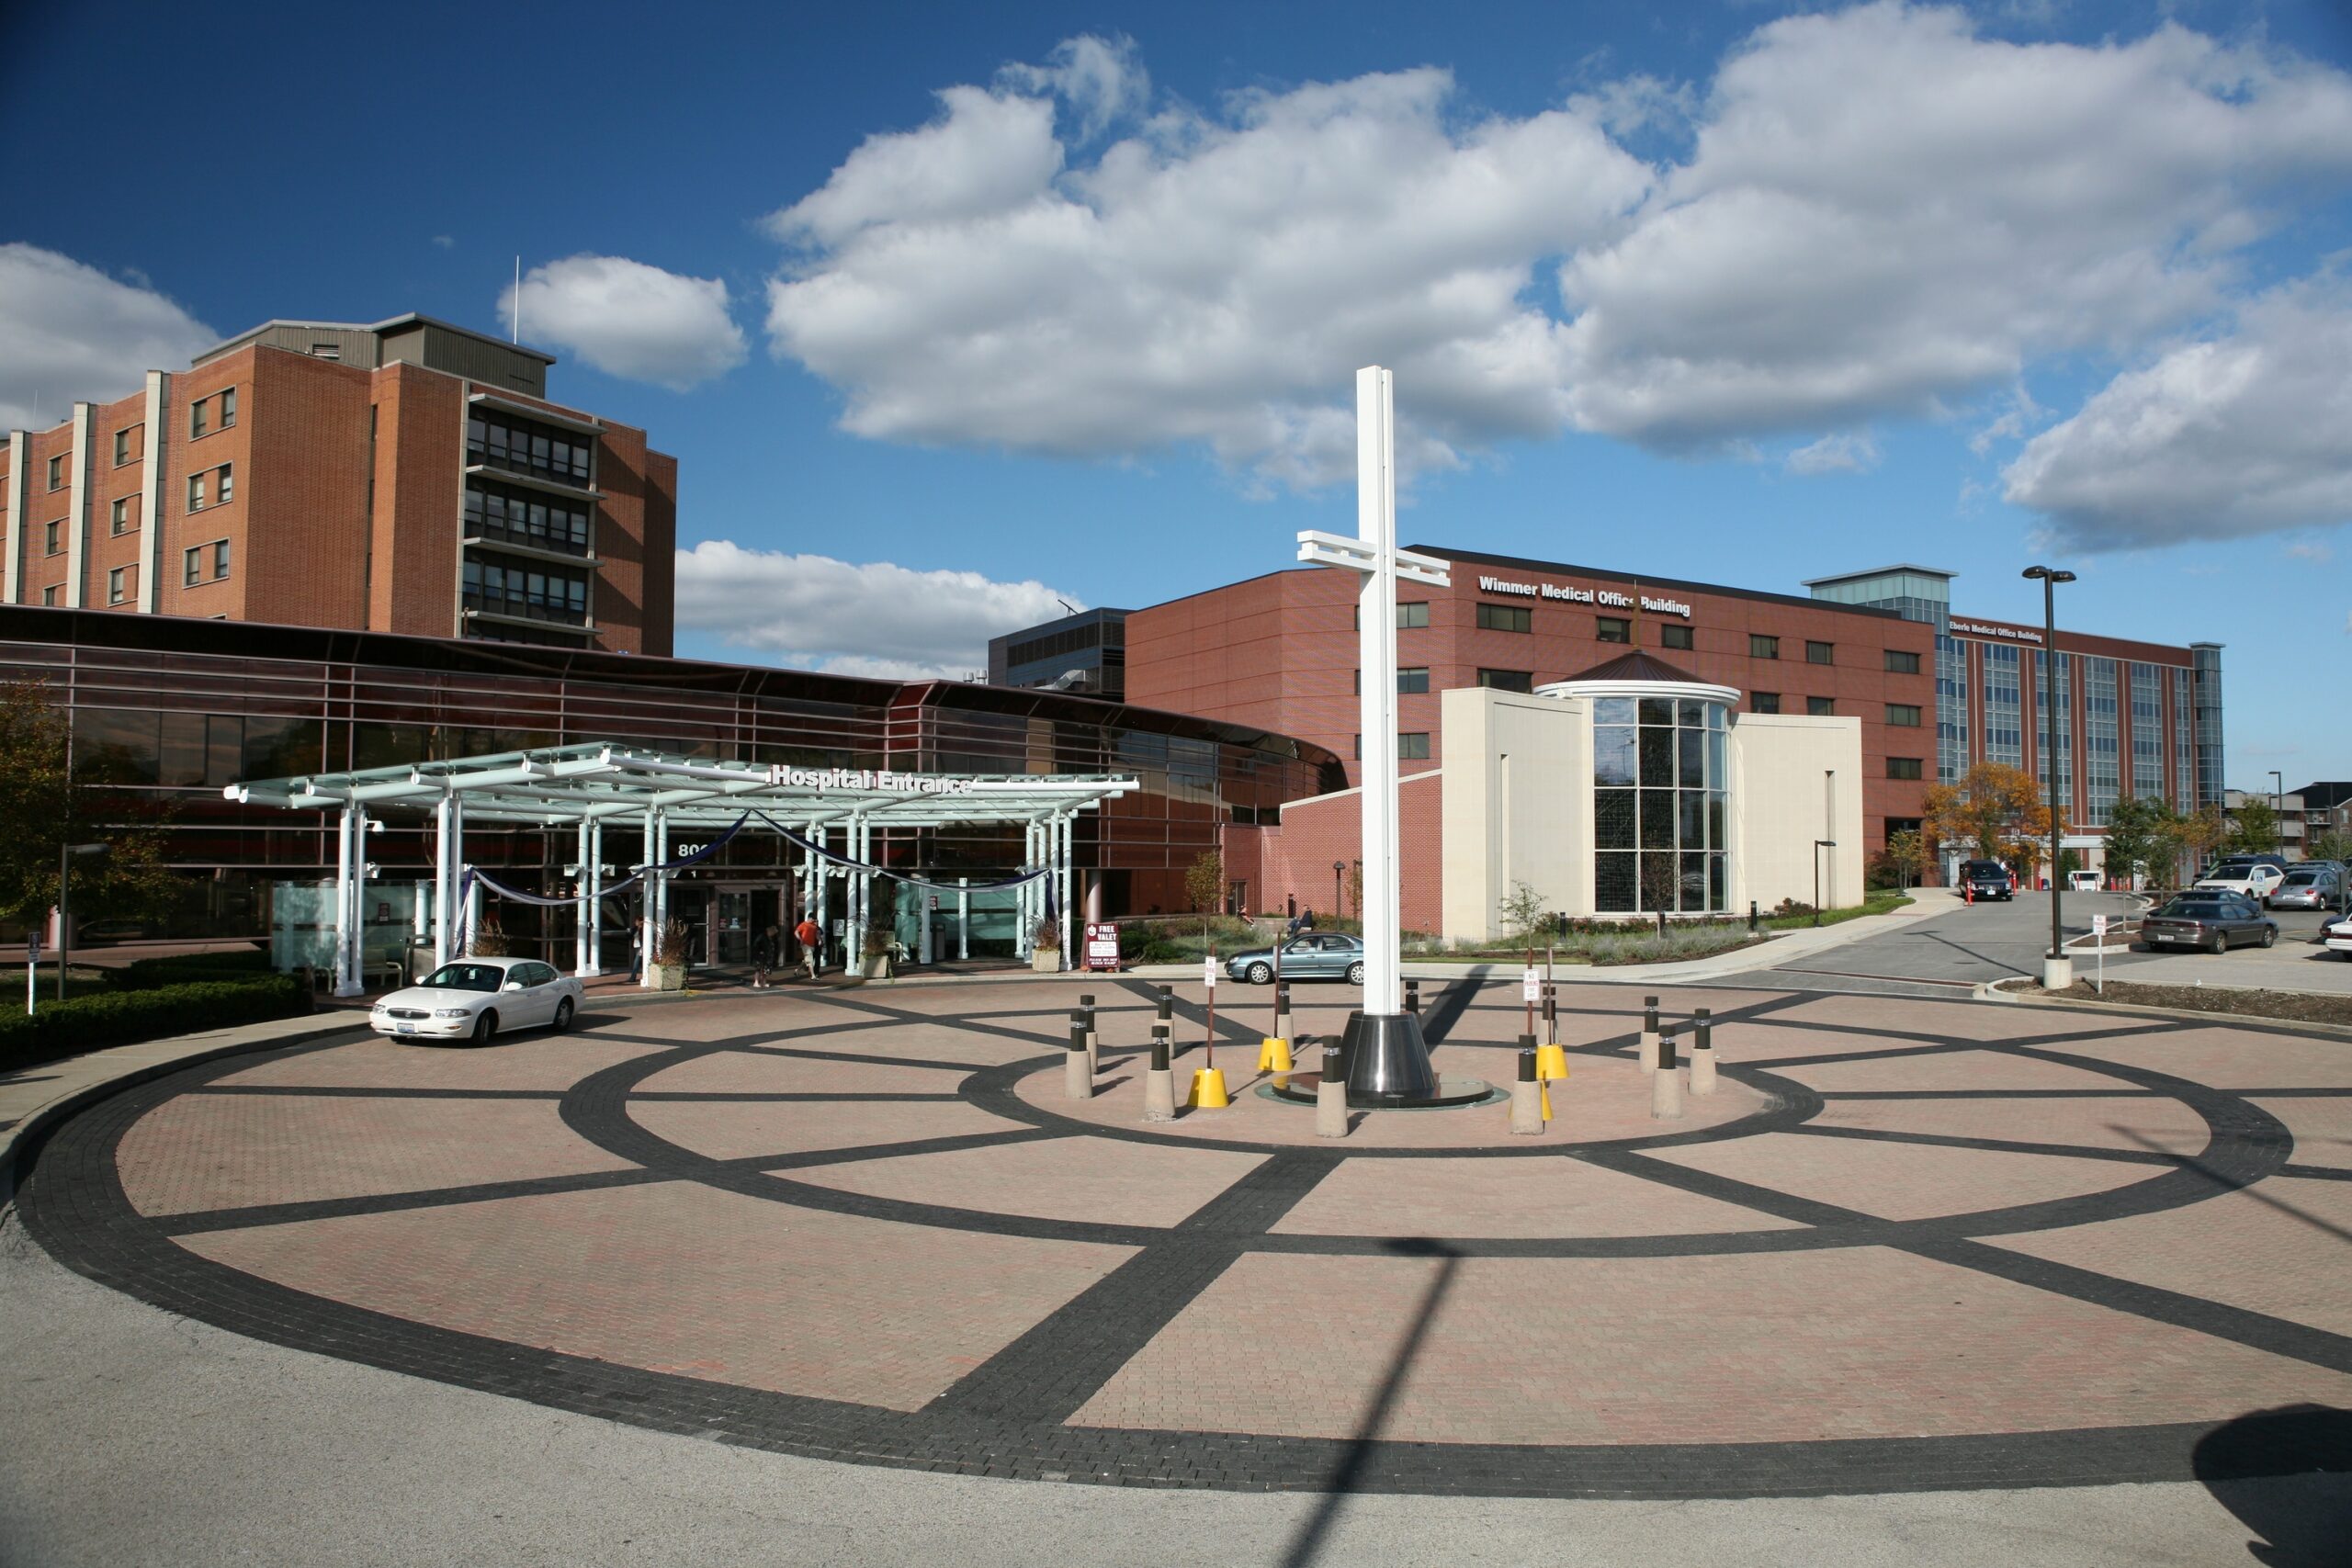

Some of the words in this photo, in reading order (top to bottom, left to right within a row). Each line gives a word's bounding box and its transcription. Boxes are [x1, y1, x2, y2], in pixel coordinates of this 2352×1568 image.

[1479, 575, 1538, 596] Wimmer
[1542, 583, 1594, 603] Medical
[1640, 596, 1690, 617] Building
[1949, 621, 1970, 632] Eberle
[1972, 625, 1996, 635] Medical
[1997, 628, 2017, 637] Office
[2018, 631, 2042, 643] Building
[771, 764, 870, 791] Hospital
[877, 771, 973, 794] Entrance
[1098, 925, 1115, 933] FREE
